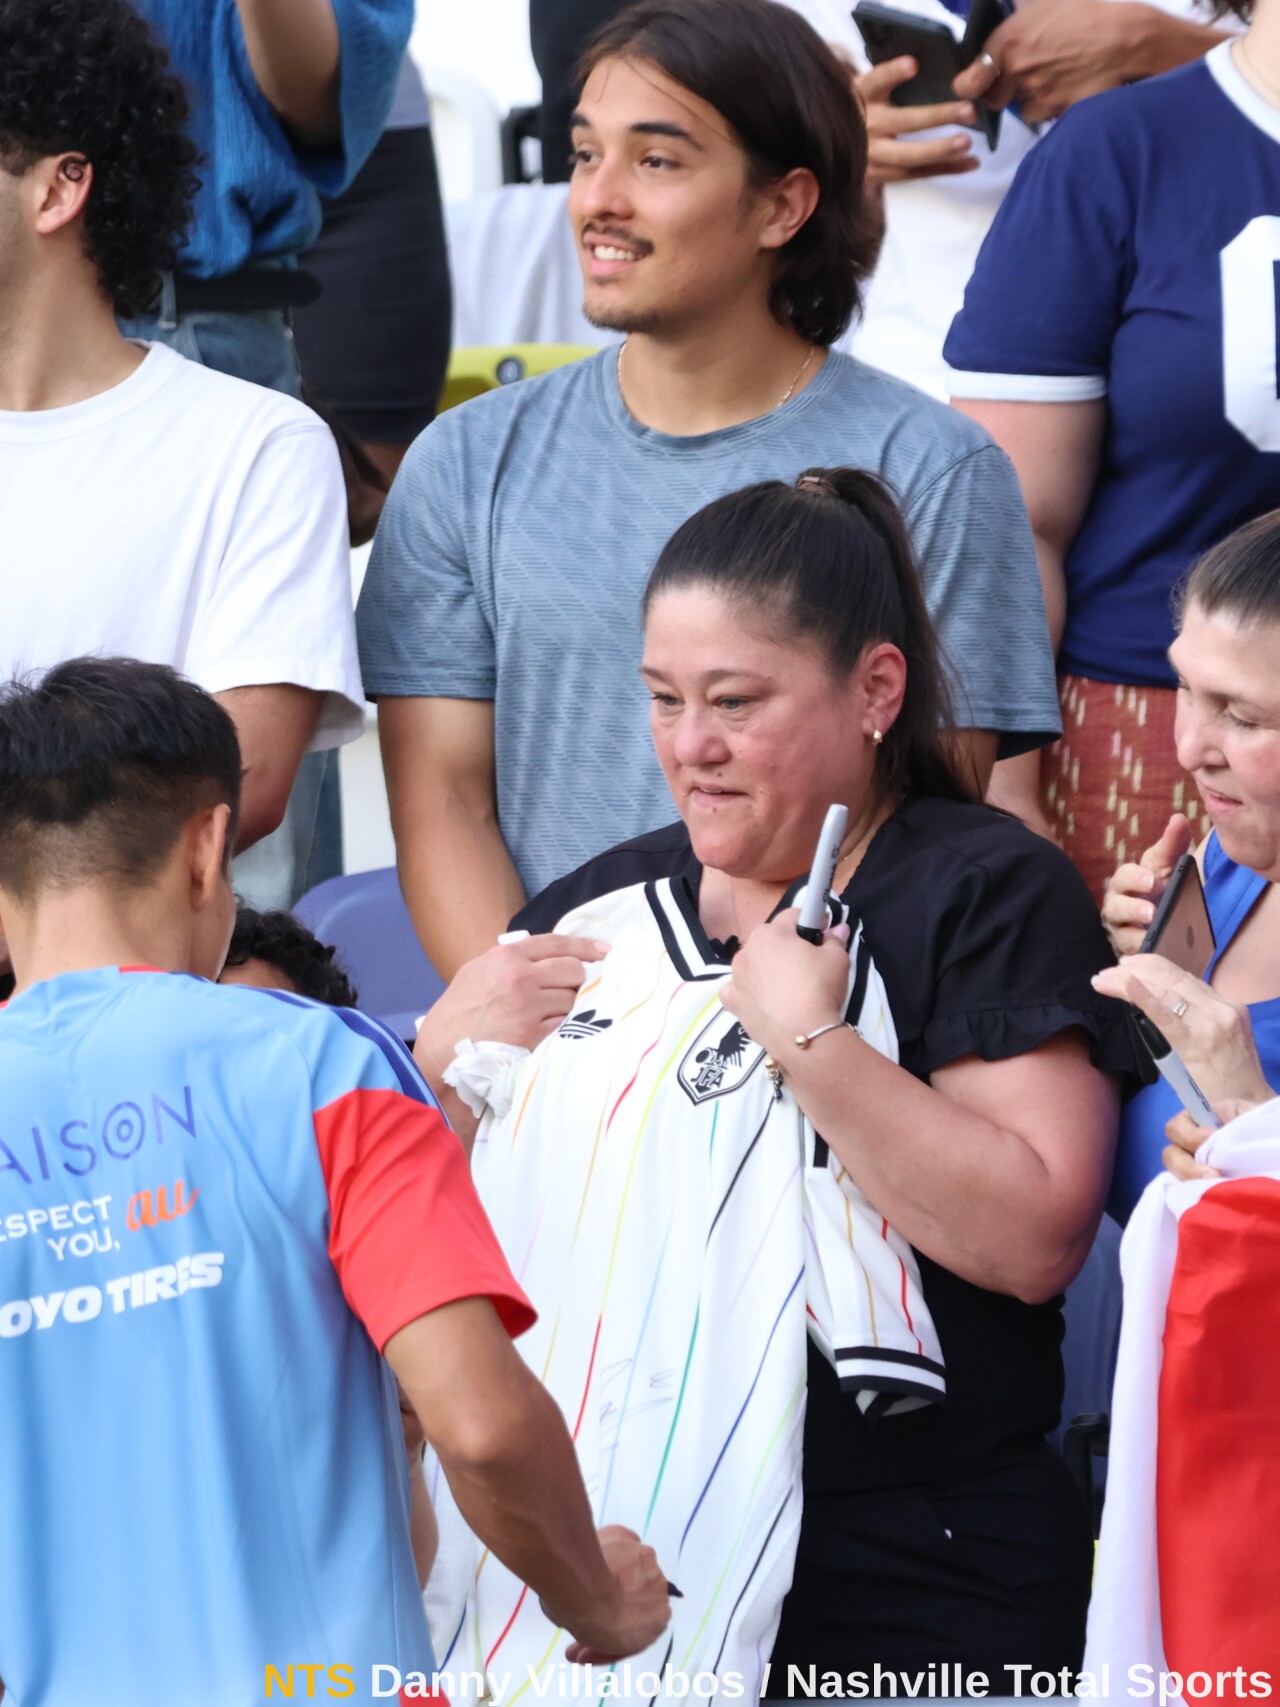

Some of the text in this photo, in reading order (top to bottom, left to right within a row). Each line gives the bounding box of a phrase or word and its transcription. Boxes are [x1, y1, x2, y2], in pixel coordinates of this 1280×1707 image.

[690, 1067, 724, 1088] JFA
[47, 1227, 121, 1261] YOU,
[106, 1252, 225, 1313] TIRES
